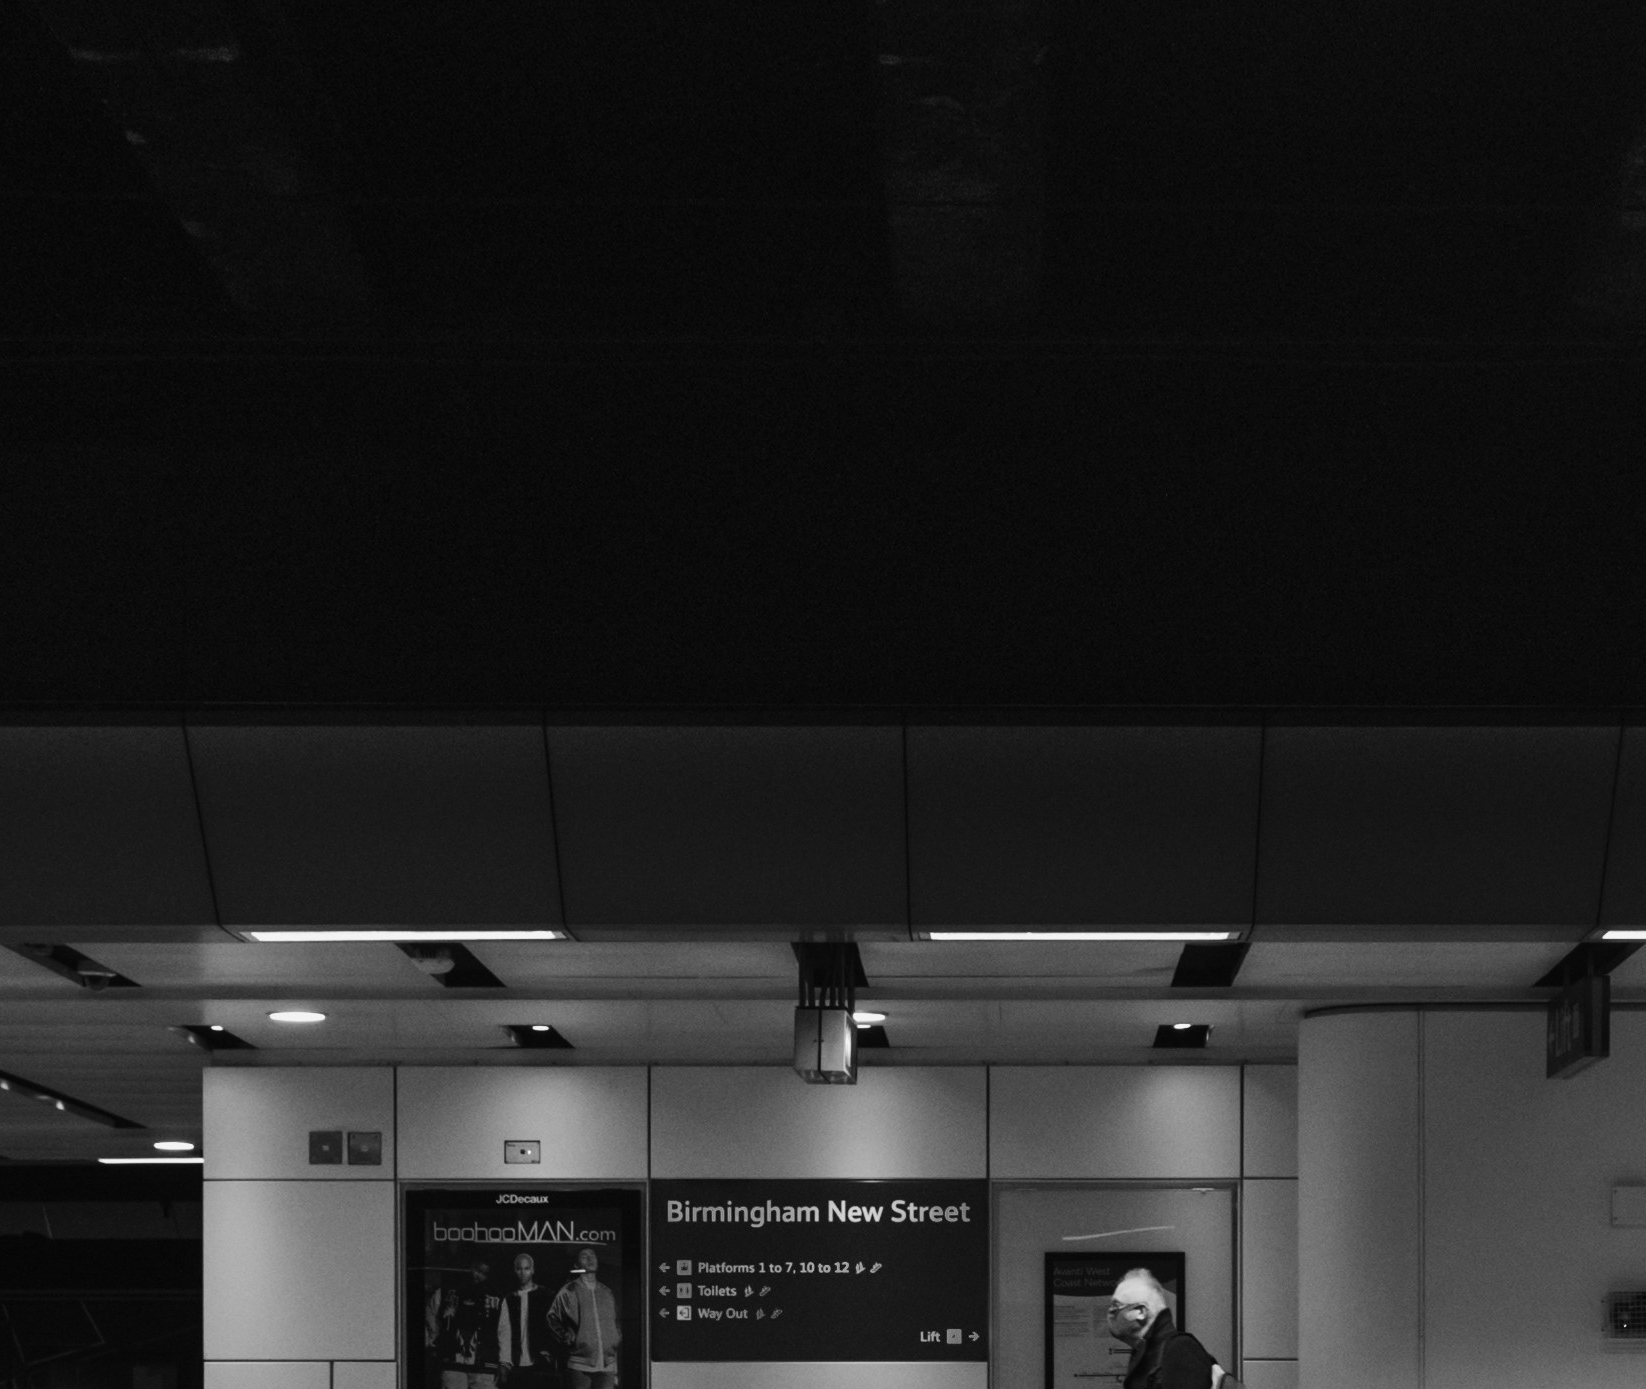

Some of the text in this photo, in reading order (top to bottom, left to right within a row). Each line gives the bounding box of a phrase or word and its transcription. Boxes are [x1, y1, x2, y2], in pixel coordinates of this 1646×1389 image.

[496, 1194, 549, 1205] JCDecaux
[667, 1200, 971, 1228] Birmingham New Street
[433, 1220, 616, 1242] boohooMAN.com
[698, 1261, 850, 1275] Platforms 1 to 7, 10 to 12
[1084, 1279, 1116, 1288] Netwo
[698, 1285, 737, 1297] Toilets
[698, 1308, 748, 1321] Way Out
[920, 1331, 941, 1343] Lift
